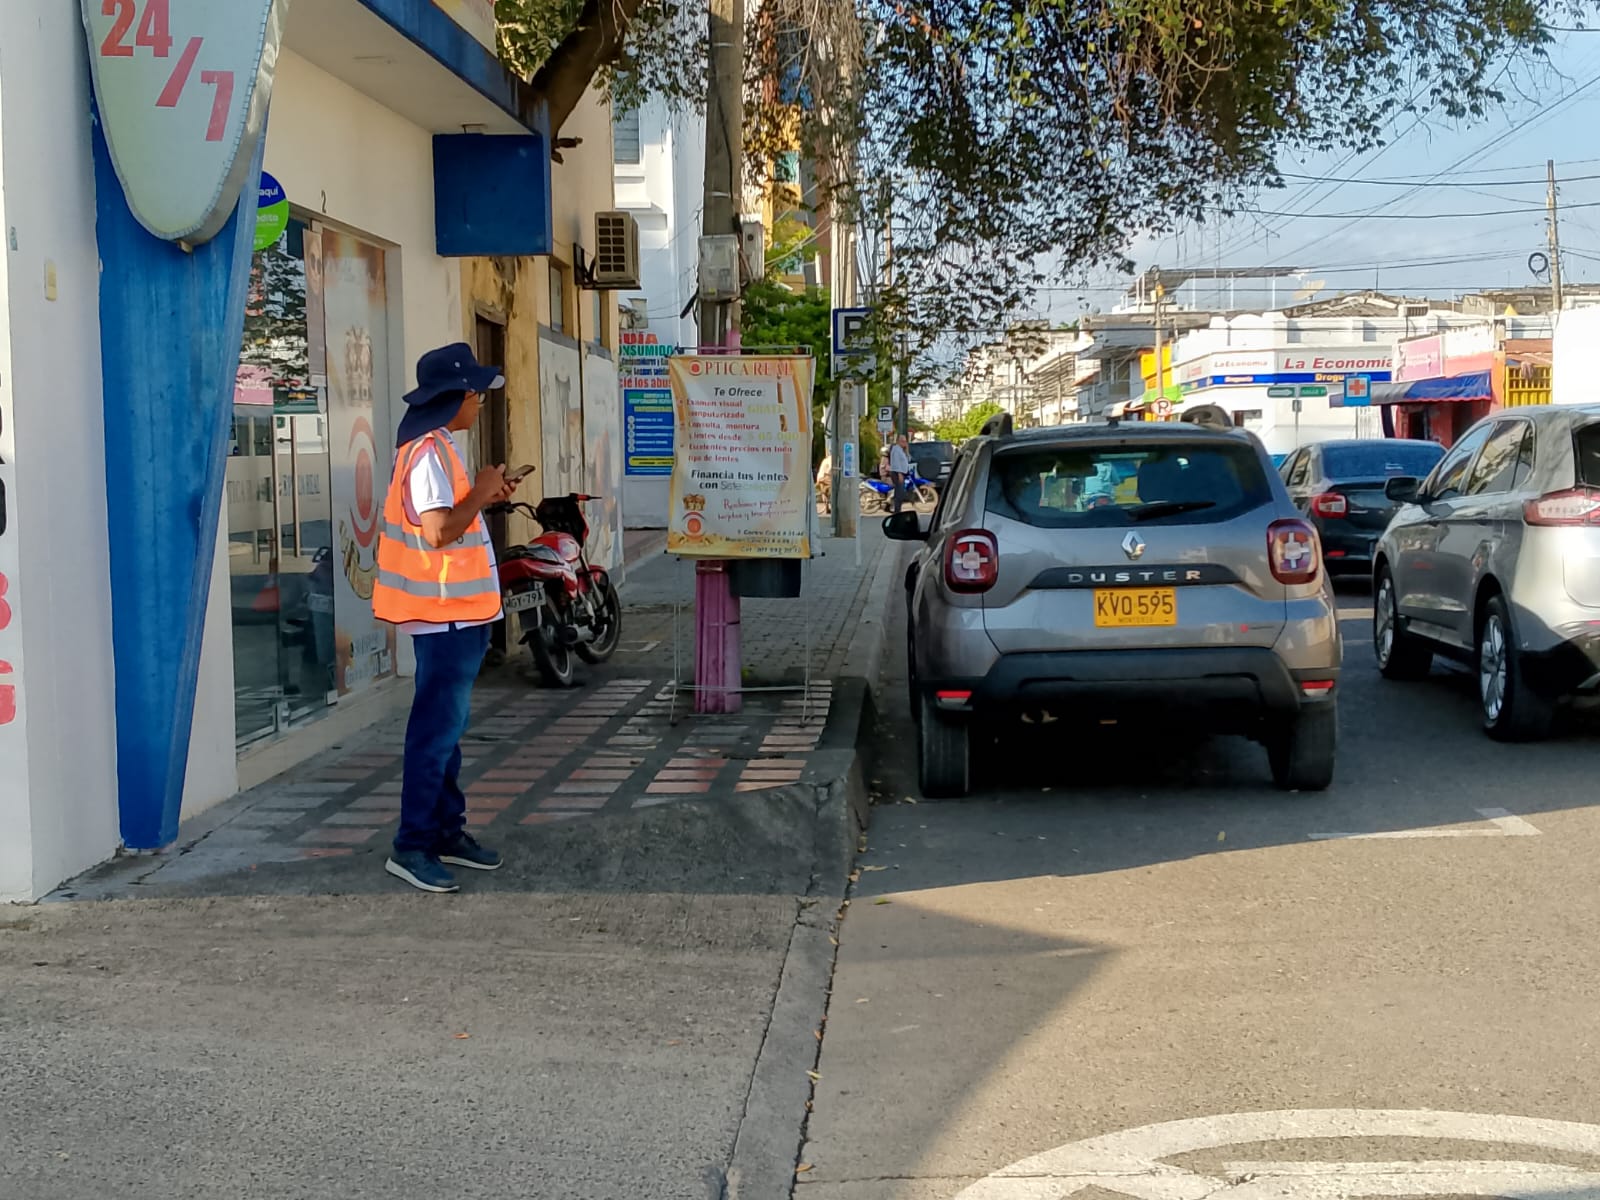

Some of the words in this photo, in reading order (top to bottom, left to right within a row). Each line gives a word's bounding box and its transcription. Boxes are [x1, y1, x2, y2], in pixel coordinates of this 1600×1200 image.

[101, 0, 234, 142] 24/7
[619, 331, 658, 344] UÍA
[1284, 358, 1305, 369] La
[713, 387, 727, 397] Te
[881, 408, 890, 420] P
[704, 454, 713, 462] de
[691, 469, 734, 480] Financia
[737, 471, 754, 481] tus
[757, 472, 789, 482] lentes
[699, 481, 719, 490] con
[1068, 570, 1201, 583] DUSTER
[1138, 594, 1174, 615] 595
